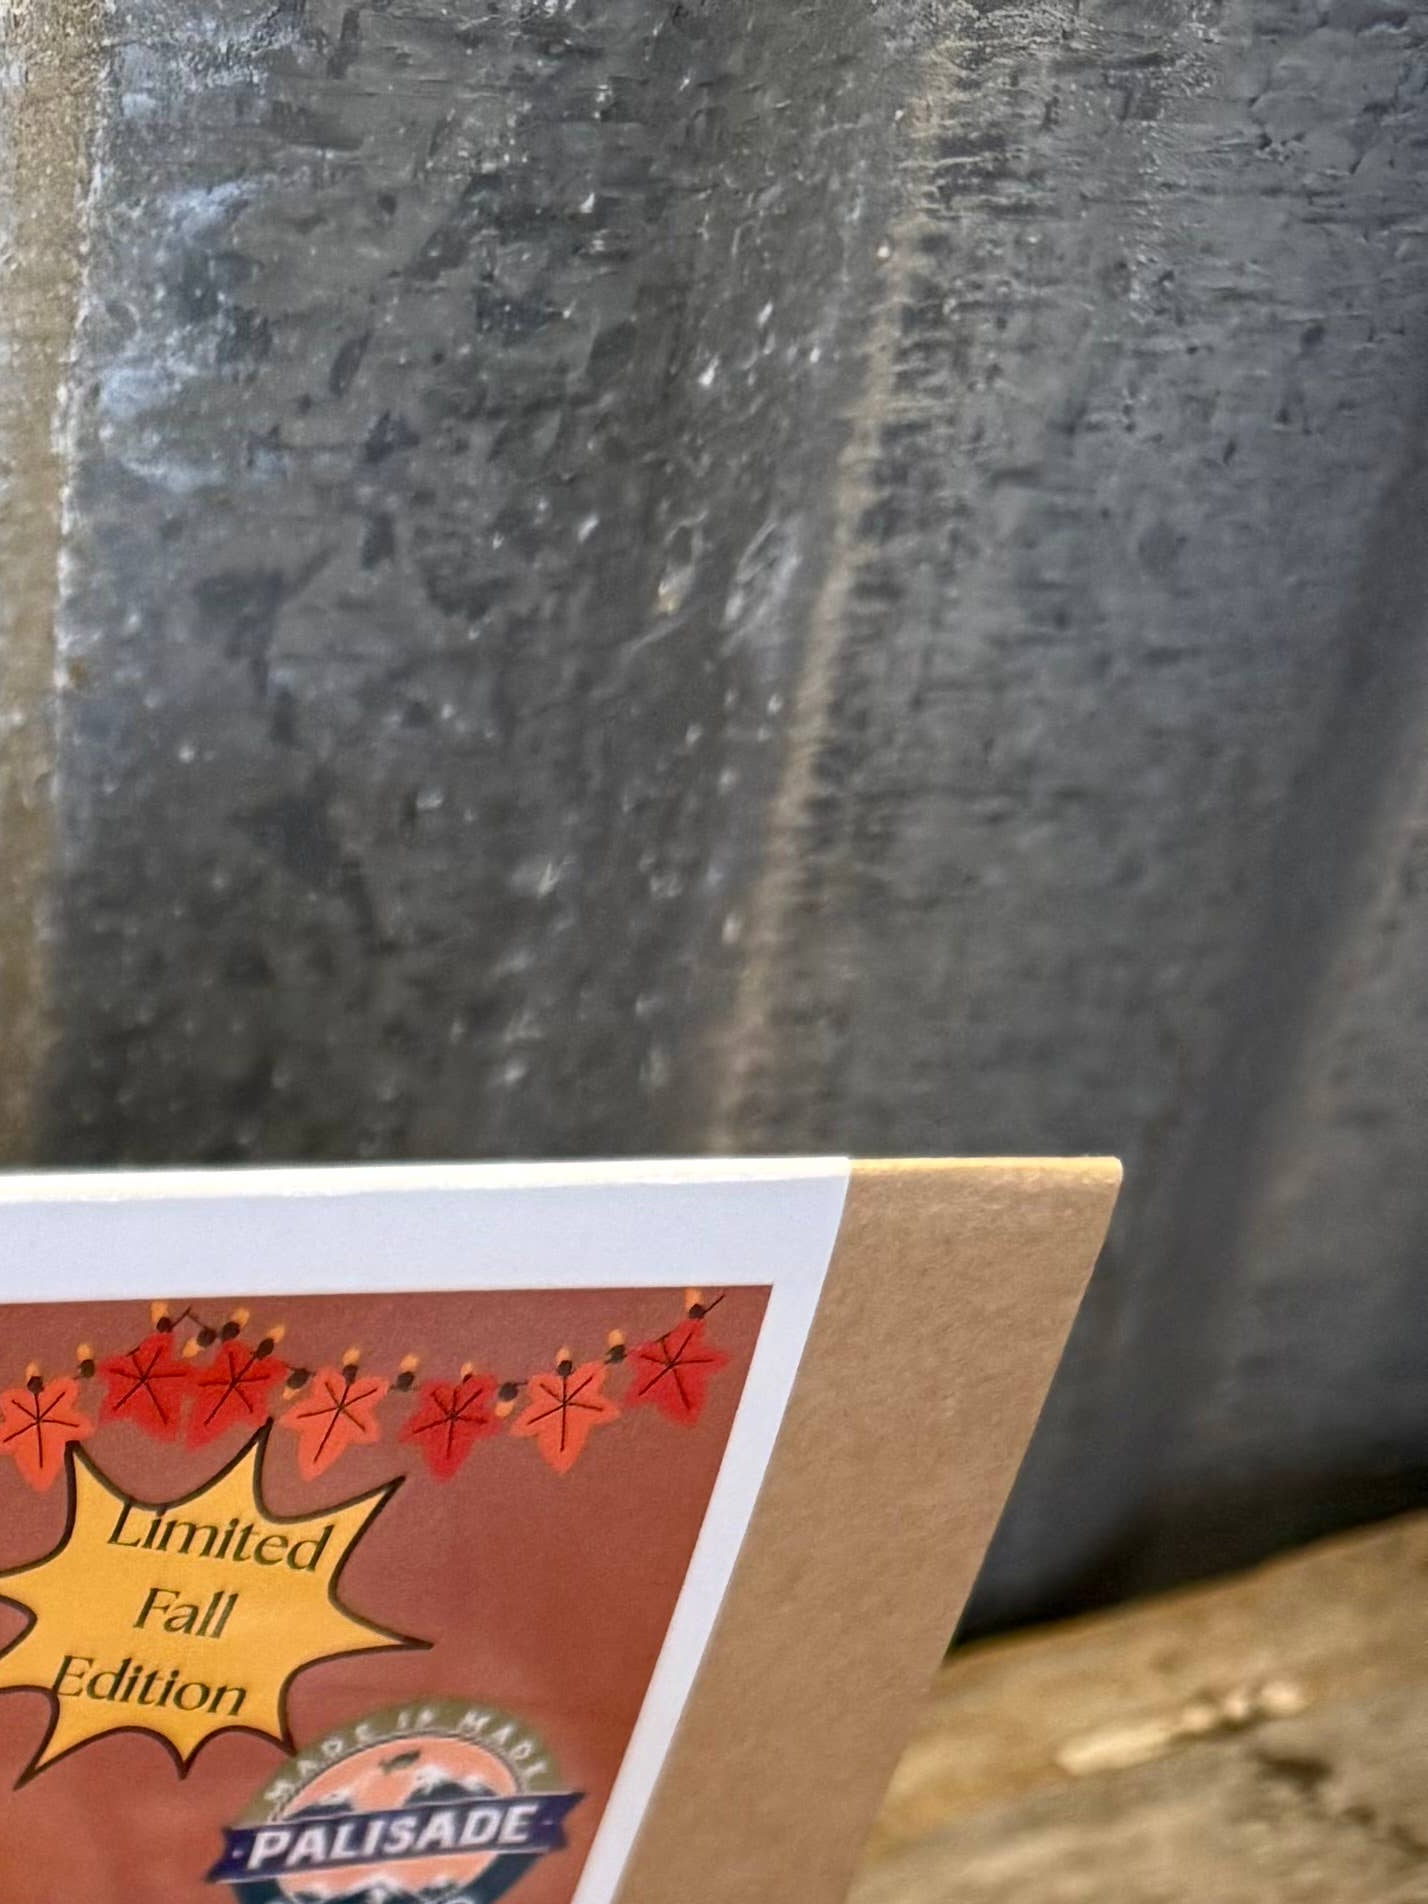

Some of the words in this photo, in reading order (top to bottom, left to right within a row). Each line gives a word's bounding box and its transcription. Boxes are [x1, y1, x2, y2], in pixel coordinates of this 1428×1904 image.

[106, 1501, 332, 1575] Limited
[134, 1587, 235, 1641] Fall
[49, 1653, 249, 1718] Edition
[247, 1803, 539, 1871] PALISADE
